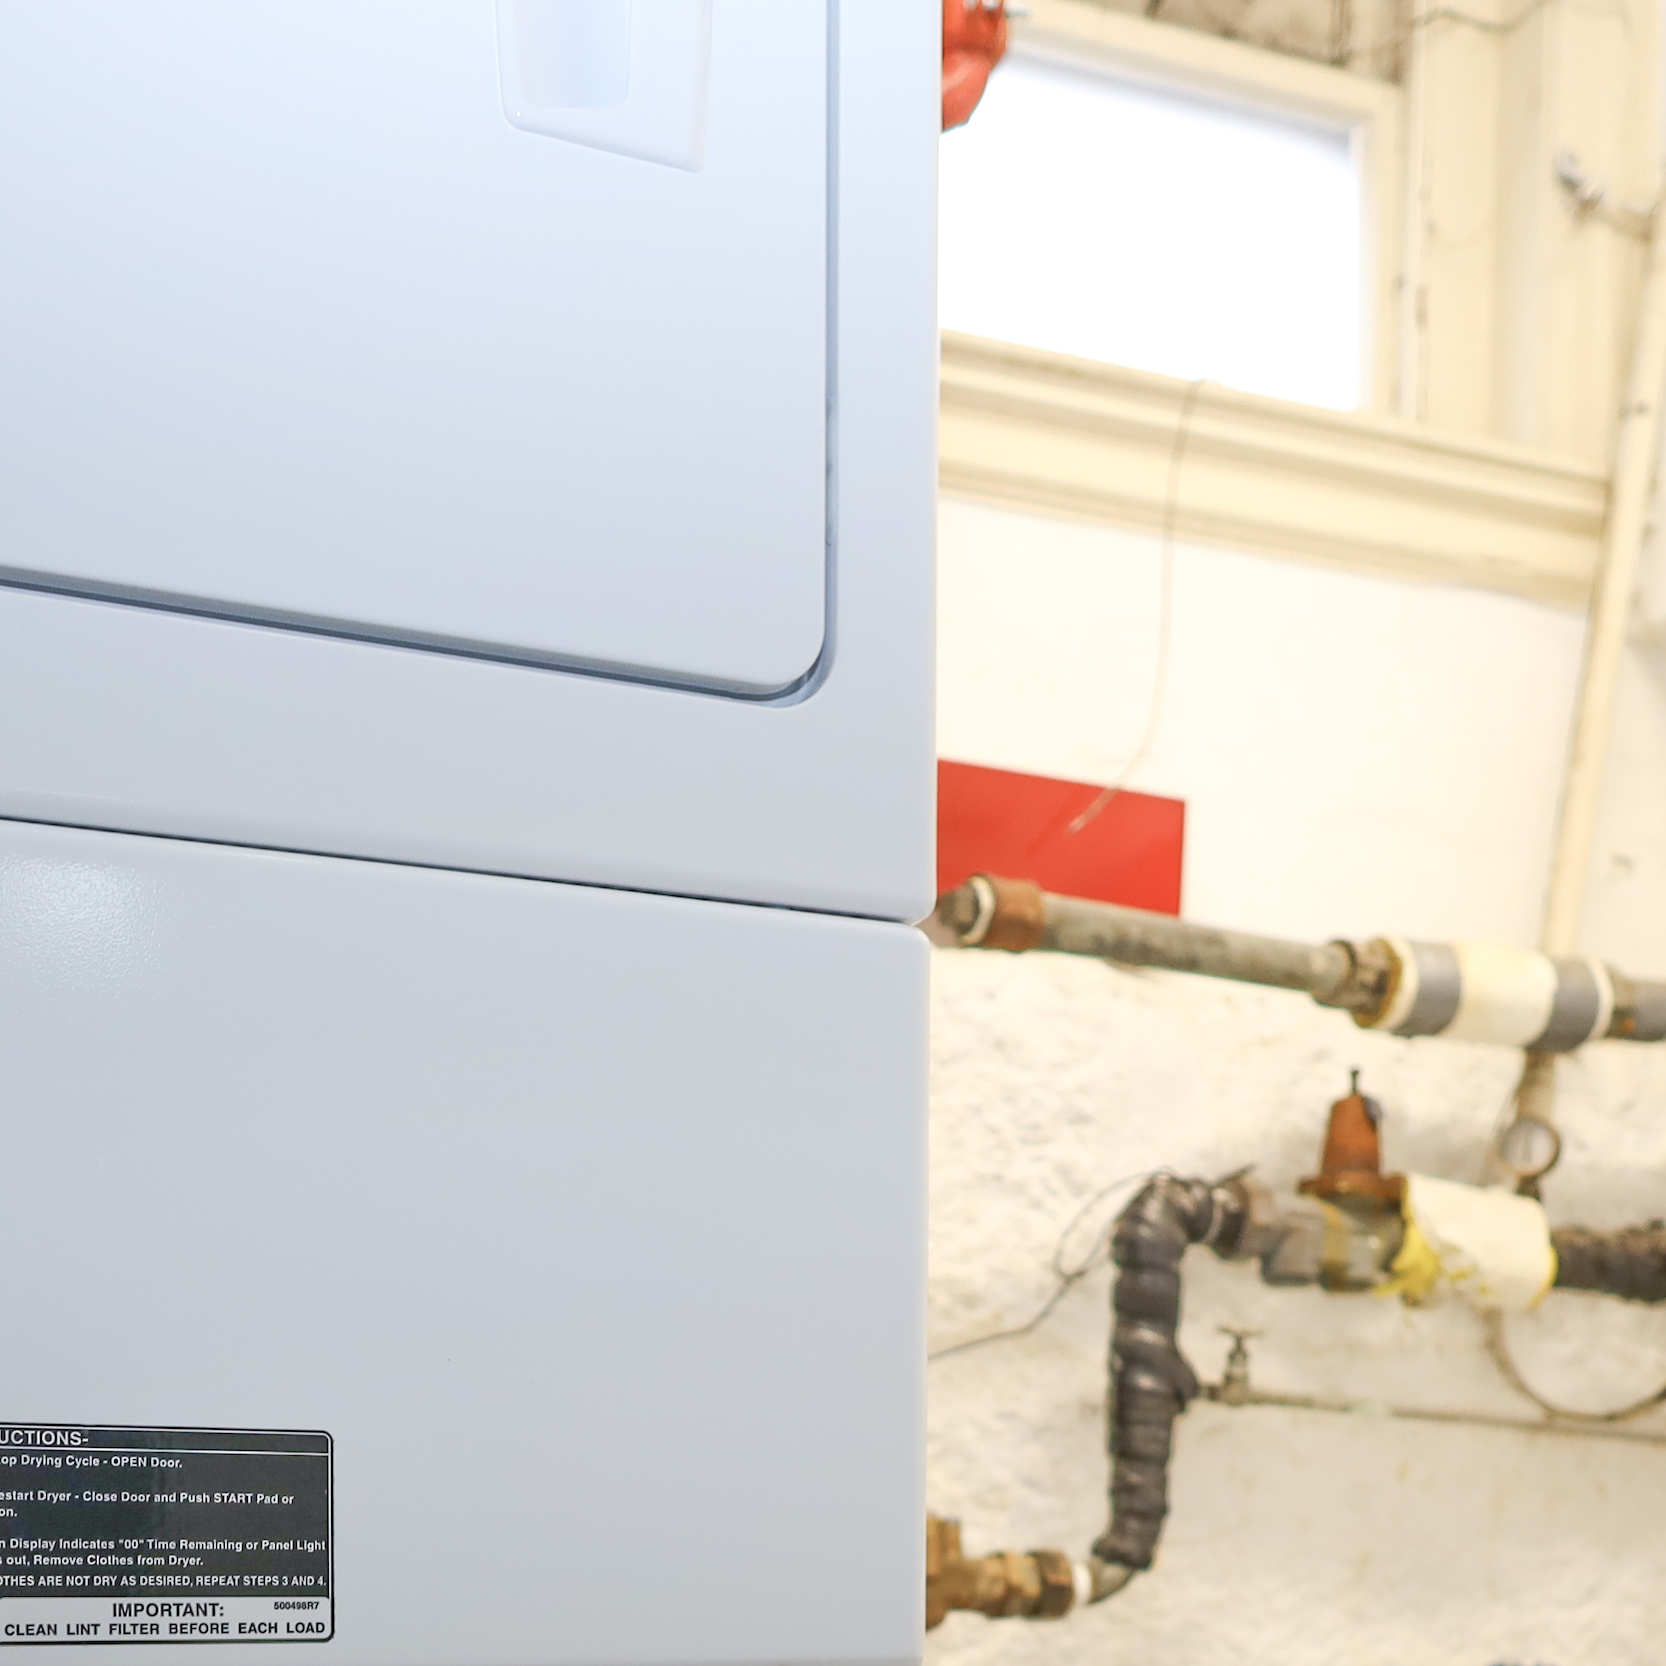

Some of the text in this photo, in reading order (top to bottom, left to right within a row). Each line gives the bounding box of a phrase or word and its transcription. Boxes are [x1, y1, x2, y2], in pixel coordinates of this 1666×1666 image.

[112, 1603, 224, 1617] IMPORTANT:
[4, 1622, 325, 1636] CLEAN LINT FILTER BEFORE EACH LOAD
